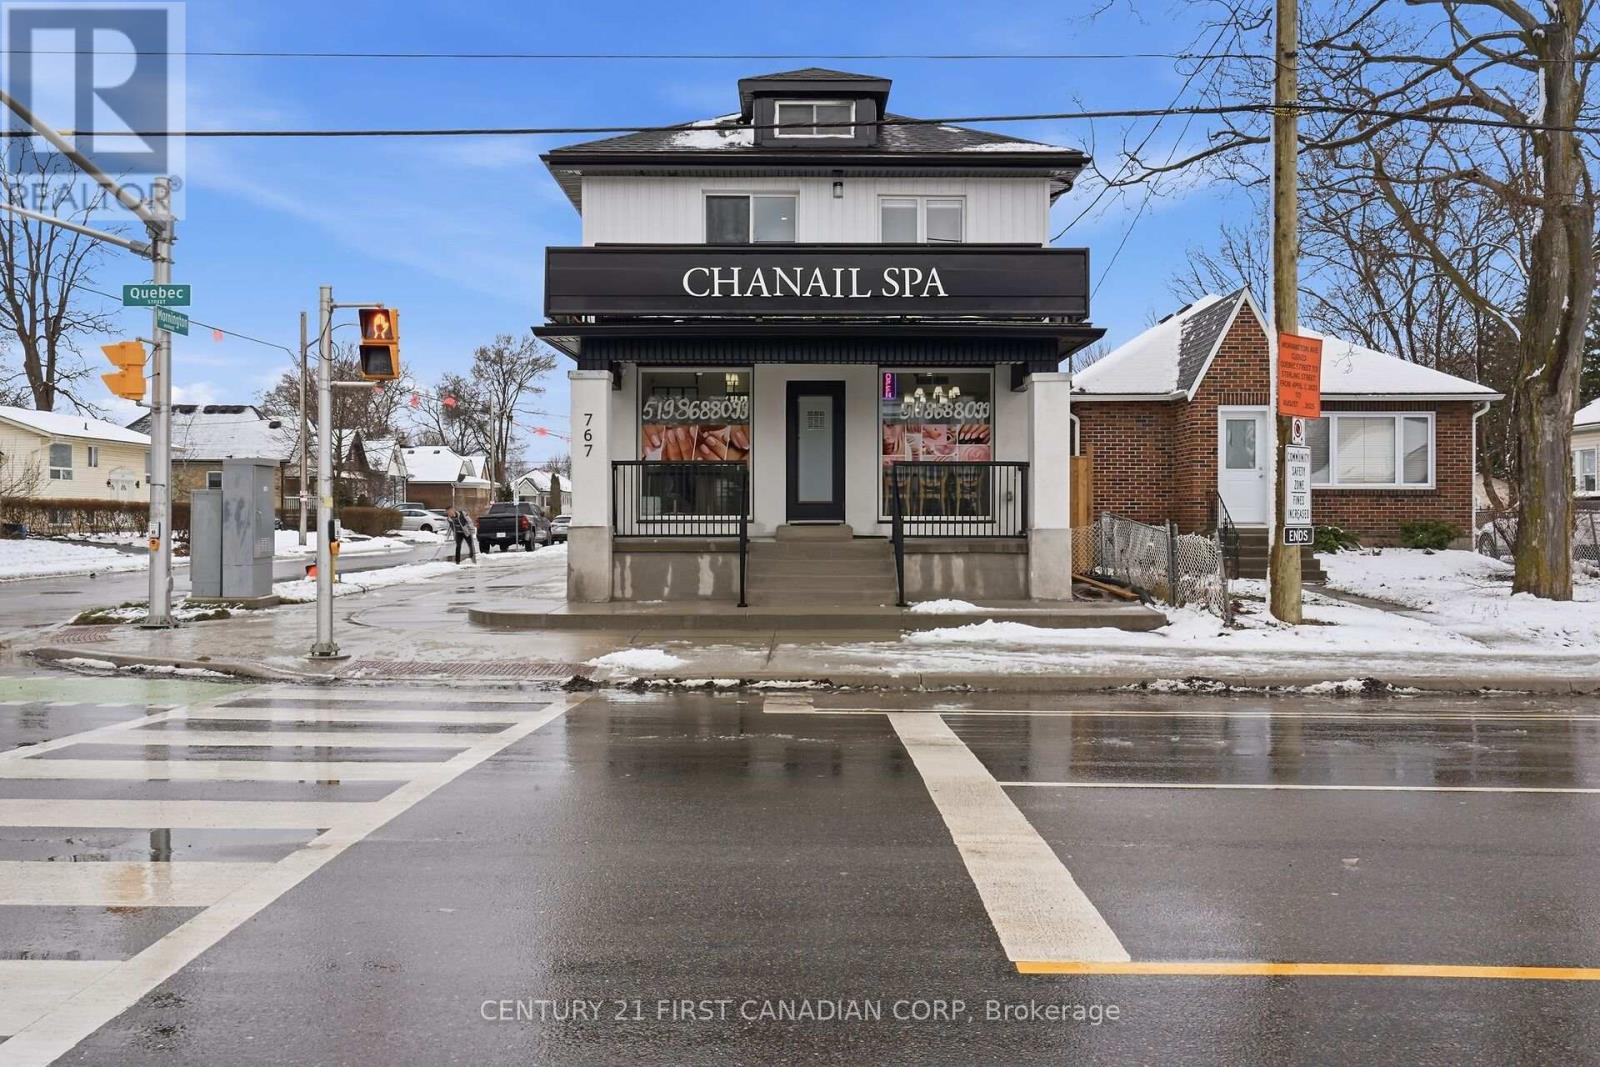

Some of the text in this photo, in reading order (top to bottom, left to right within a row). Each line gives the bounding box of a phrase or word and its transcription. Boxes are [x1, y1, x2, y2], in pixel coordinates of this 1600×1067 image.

[682, 266, 949, 298] CHANAIL SPA
[130, 286, 184, 300] Quebec
[157, 307, 188, 329] Mornington
[584, 413, 593, 458] 767
[1287, 452, 1310, 462] COMMUNITY
[1292, 466, 1306, 477] SAFETY
[1294, 479, 1305, 490] ZONE
[1292, 495, 1305, 506] FINES
[1288, 508, 1310, 519] INCREASED
[1289, 530, 1309, 542] ENDS
